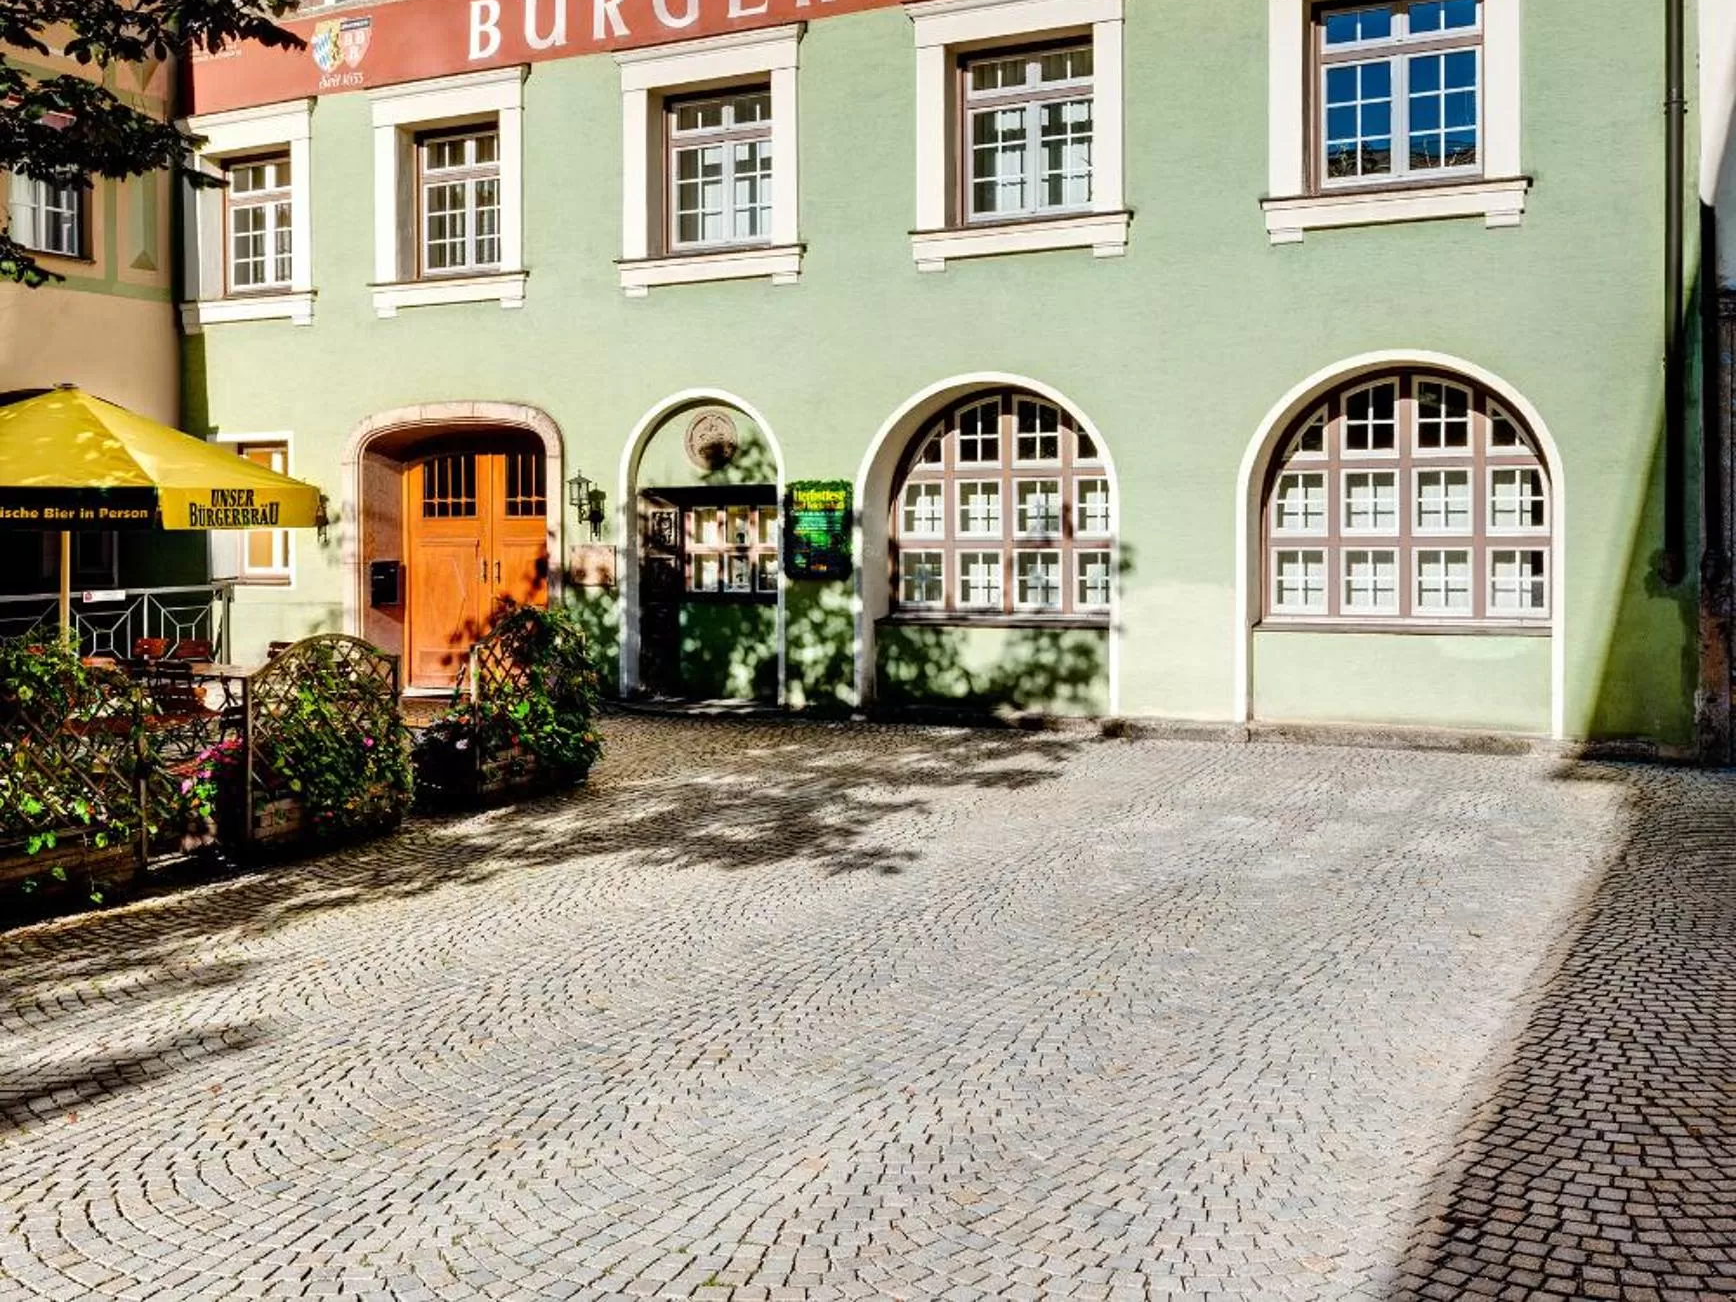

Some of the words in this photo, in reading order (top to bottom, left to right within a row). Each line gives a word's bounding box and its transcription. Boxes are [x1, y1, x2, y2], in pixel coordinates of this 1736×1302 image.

[211, 489, 254, 507] UNSER
[43, 507, 75, 518] Bier
[79, 507, 94, 518] in
[99, 508, 148, 518] Person
[189, 501, 280, 526] BÜRGERBRÄU
